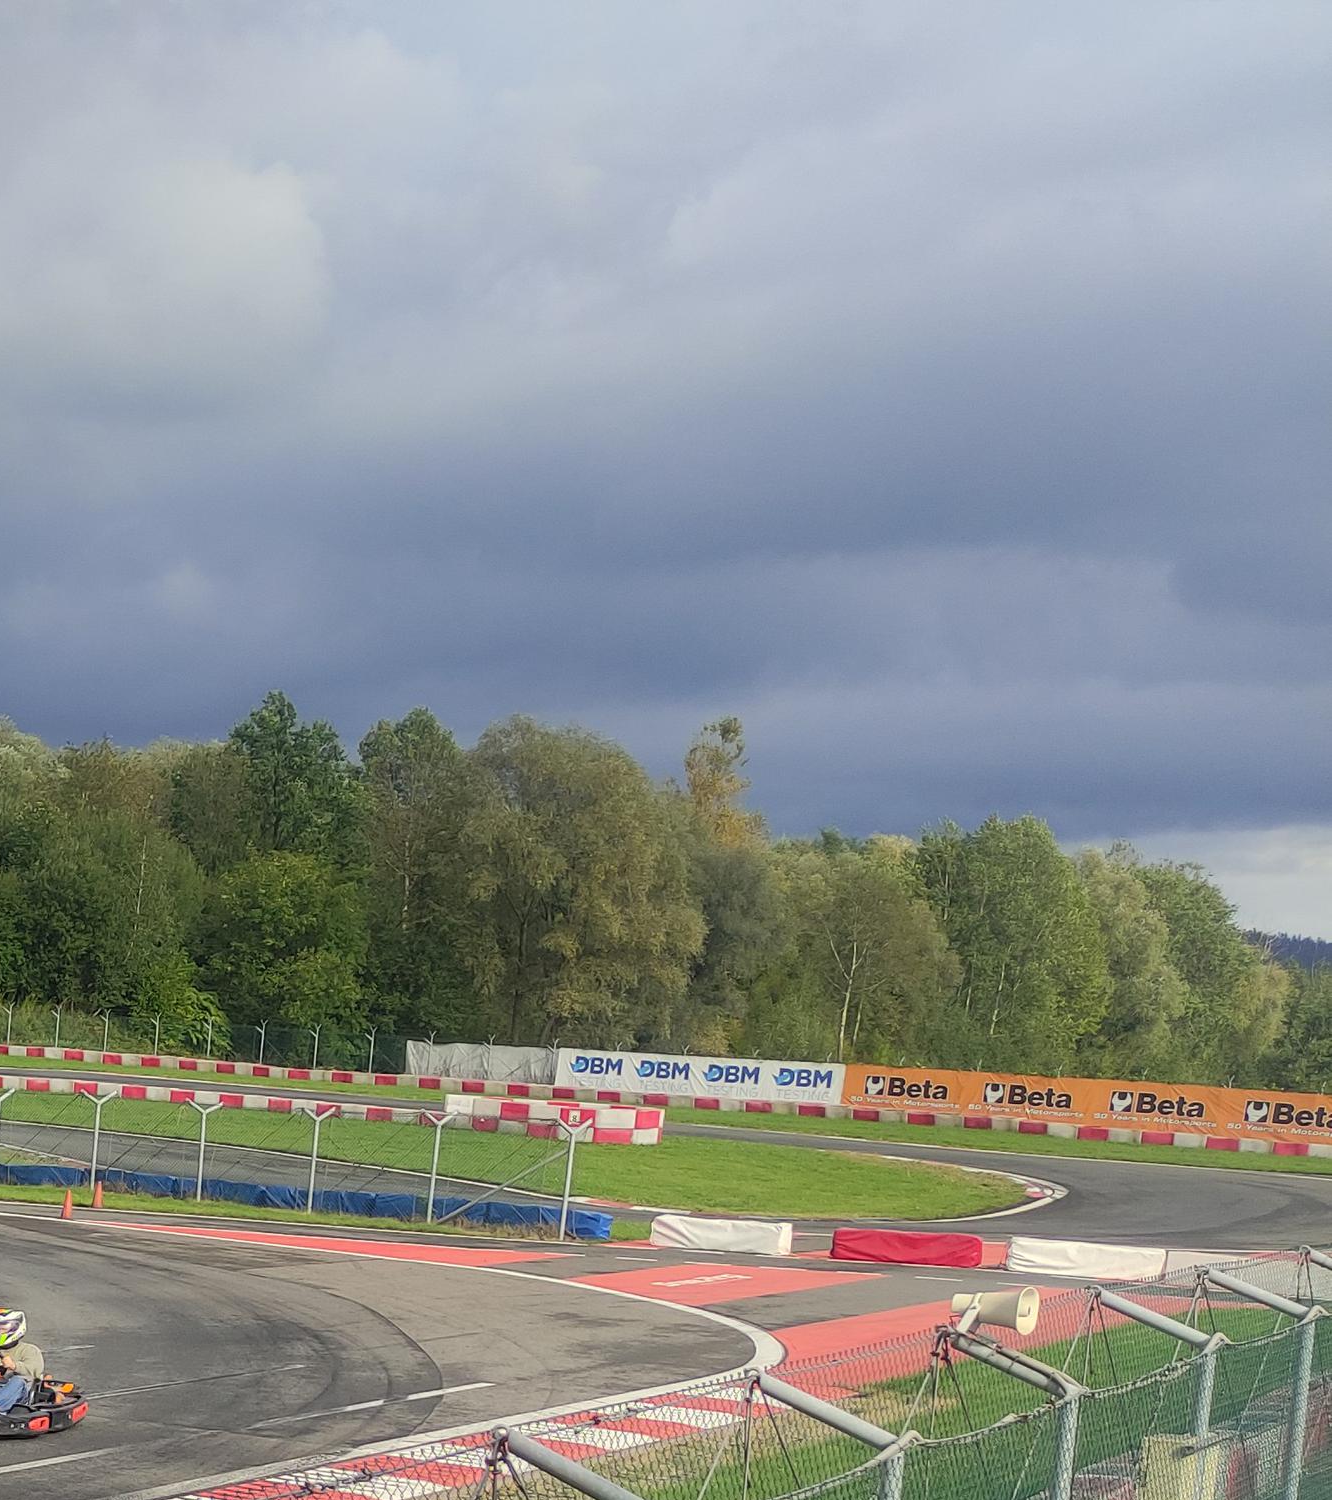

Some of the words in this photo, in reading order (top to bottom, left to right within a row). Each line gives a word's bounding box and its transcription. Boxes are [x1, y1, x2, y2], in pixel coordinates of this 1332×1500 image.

[570, 1055, 624, 1076] DBM
[637, 1060, 691, 1080] DBM
[702, 1064, 760, 1085] DBM
[772, 1068, 833, 1089] DBM
[887, 1077, 948, 1100] Beta
[706, 1085, 758, 1098] TESTING
[776, 1089, 831, 1100] TESTING
[1008, 1085, 1072, 1108] Beta
[1136, 1093, 1204, 1118] Beta
